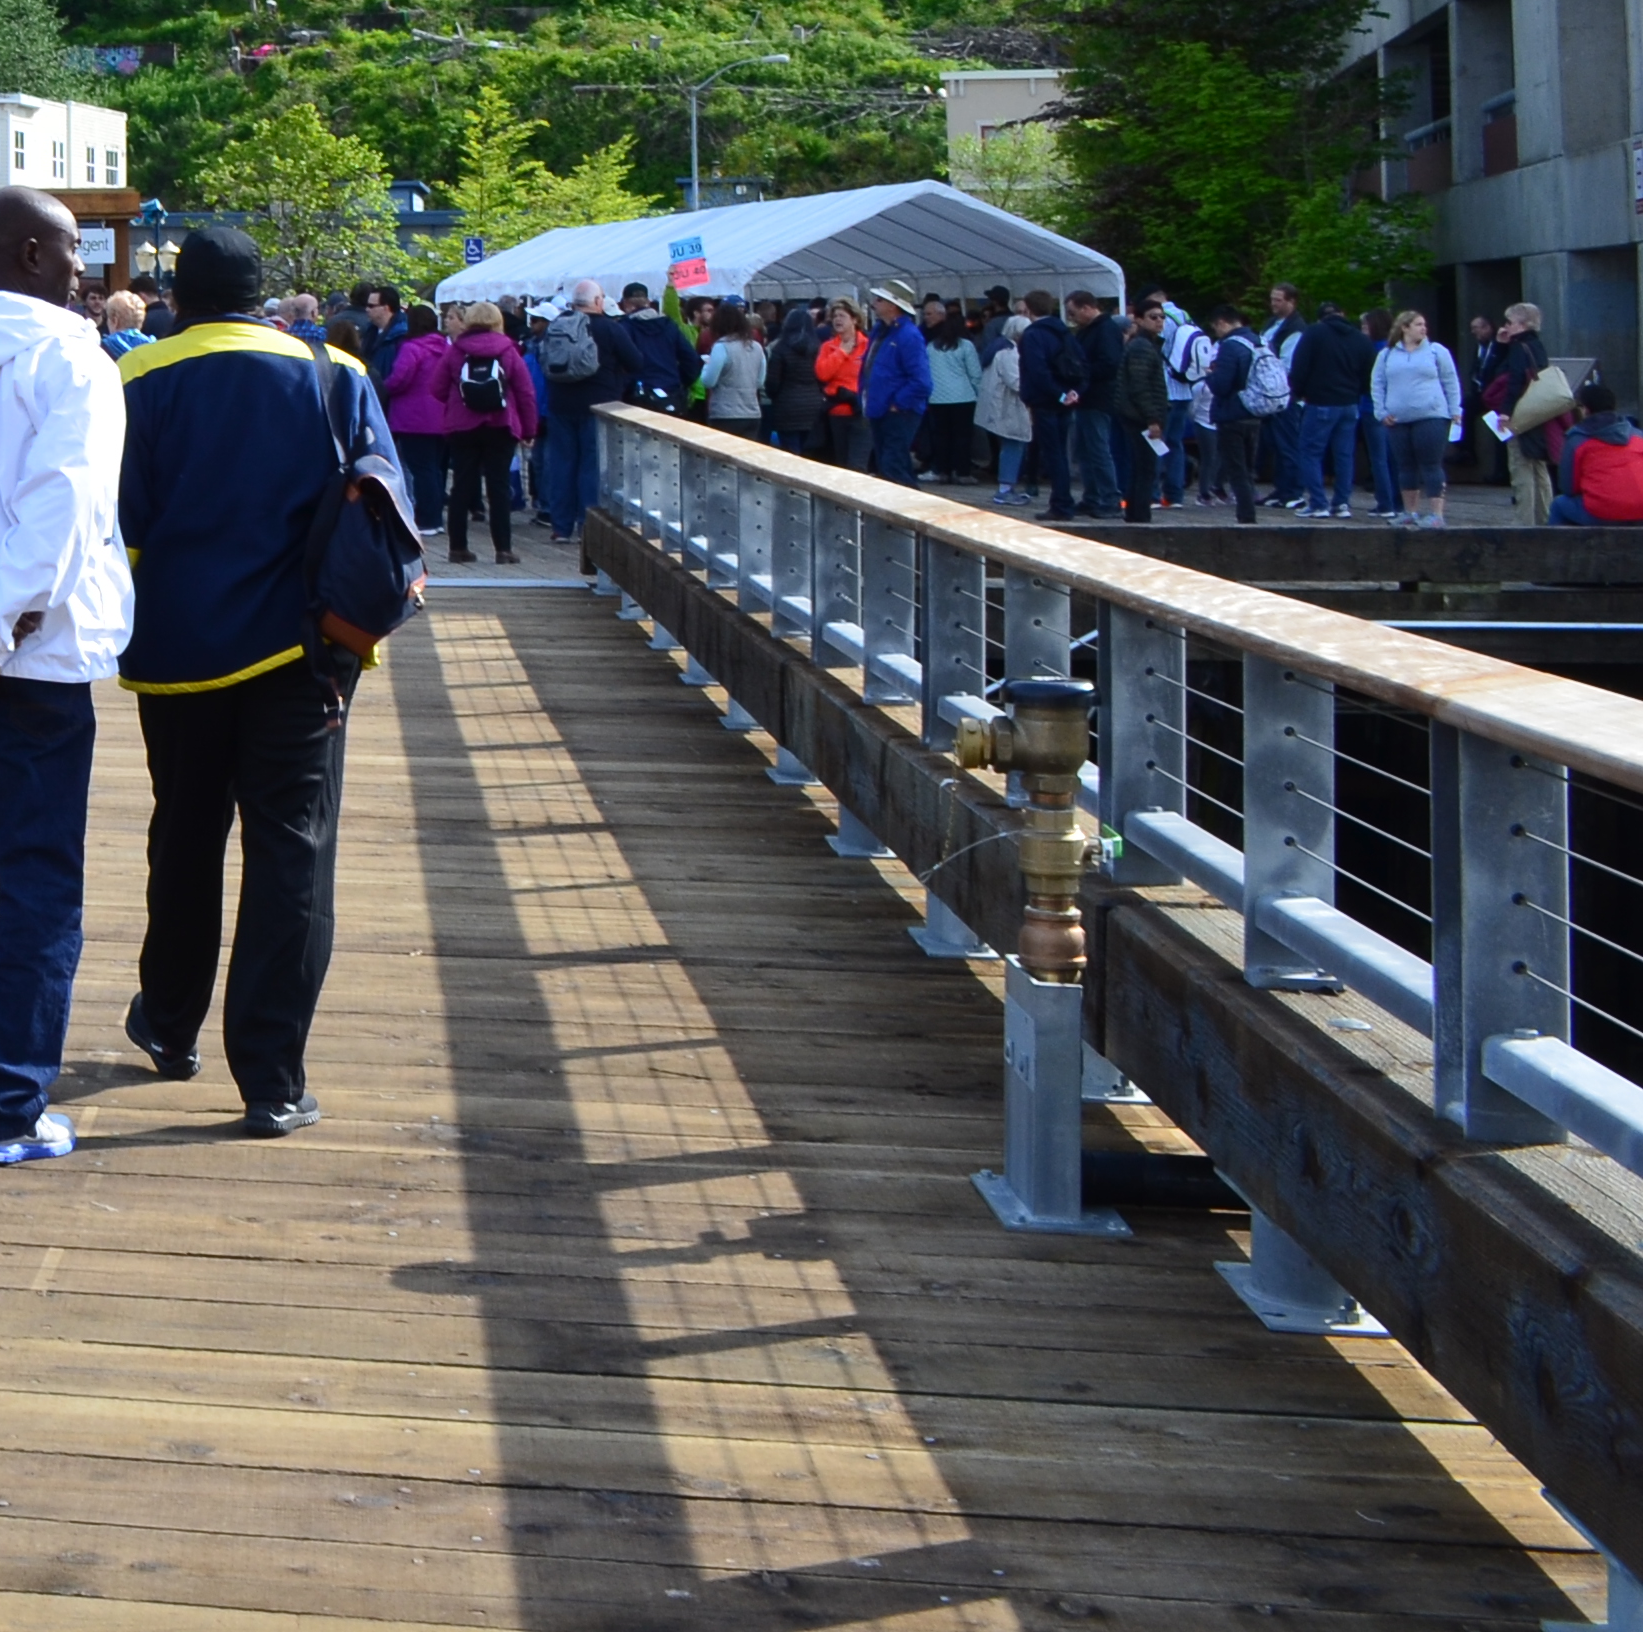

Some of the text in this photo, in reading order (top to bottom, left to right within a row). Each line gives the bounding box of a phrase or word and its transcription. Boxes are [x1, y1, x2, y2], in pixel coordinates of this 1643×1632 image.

[79, 238, 109, 256] gent
[670, 243, 702, 259] JU 39
